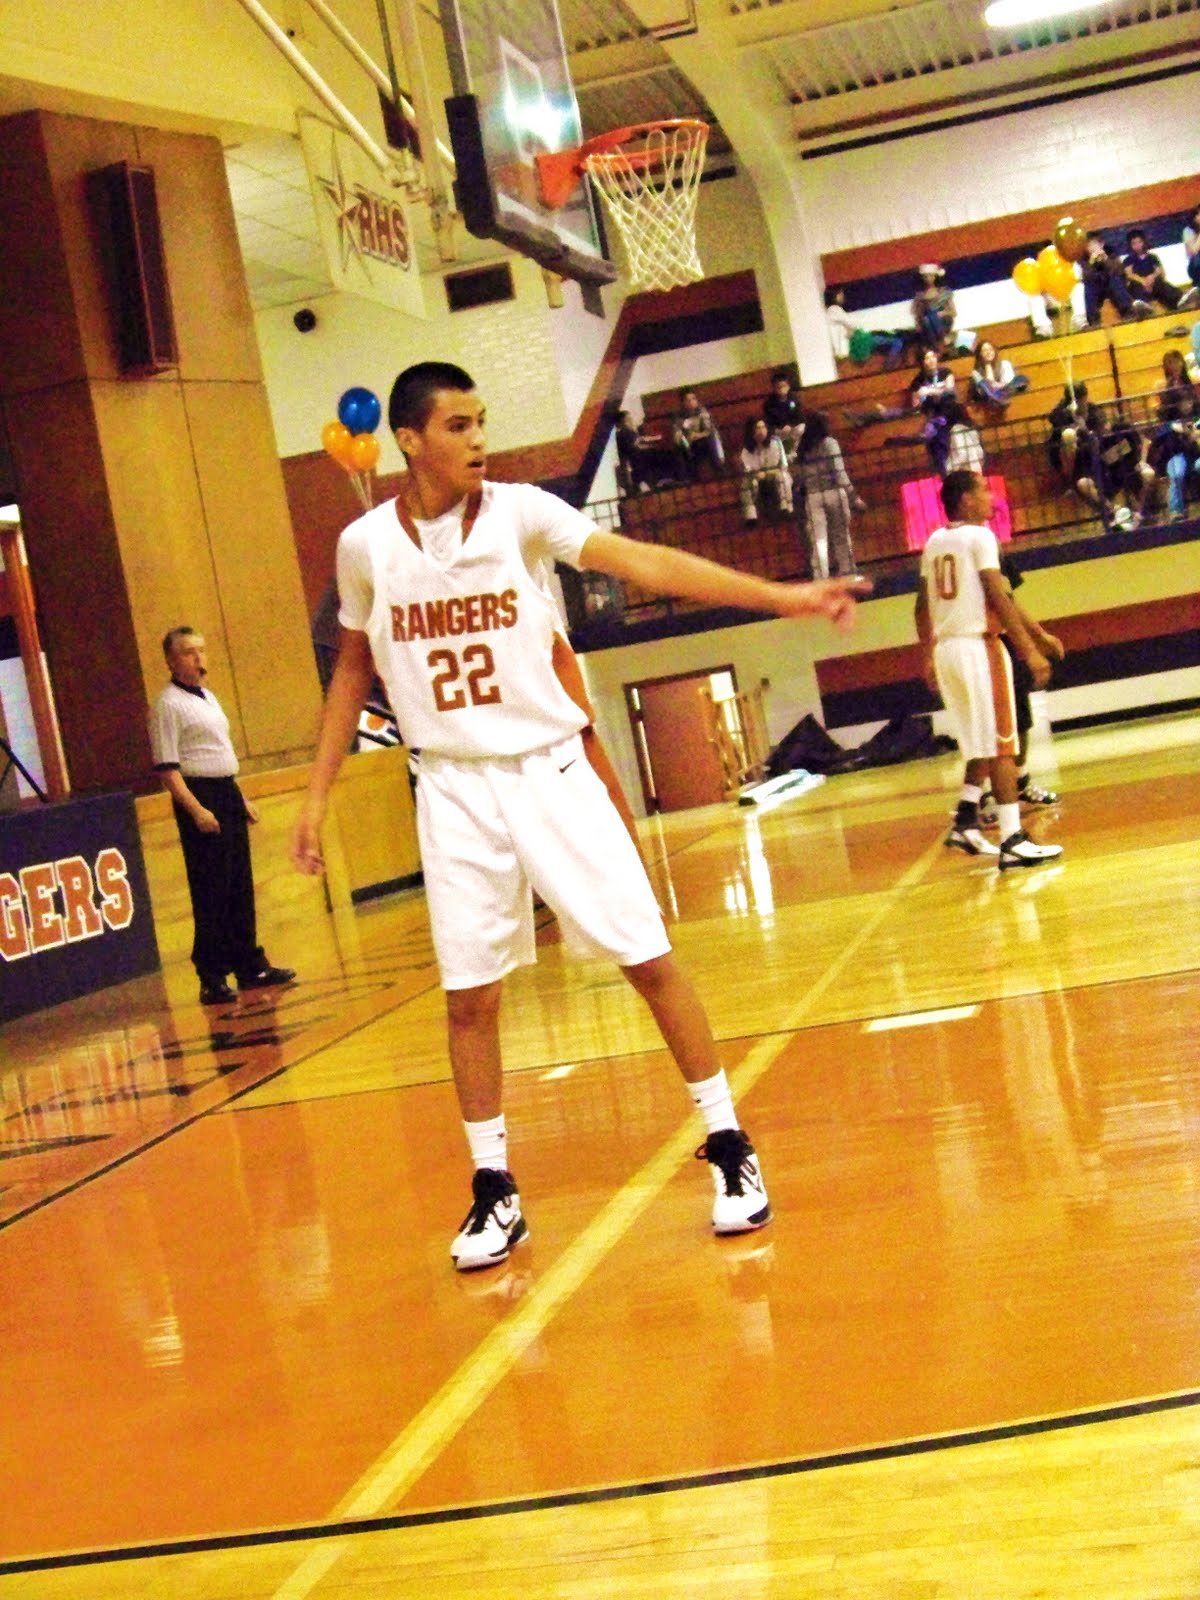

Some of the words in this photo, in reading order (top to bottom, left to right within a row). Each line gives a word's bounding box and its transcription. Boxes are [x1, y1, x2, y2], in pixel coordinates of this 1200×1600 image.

[354, 190, 410, 266] RHS
[391, 588, 518, 642] RANGERS
[427, 643, 502, 712] 22
[0, 847, 134, 962] GERS
